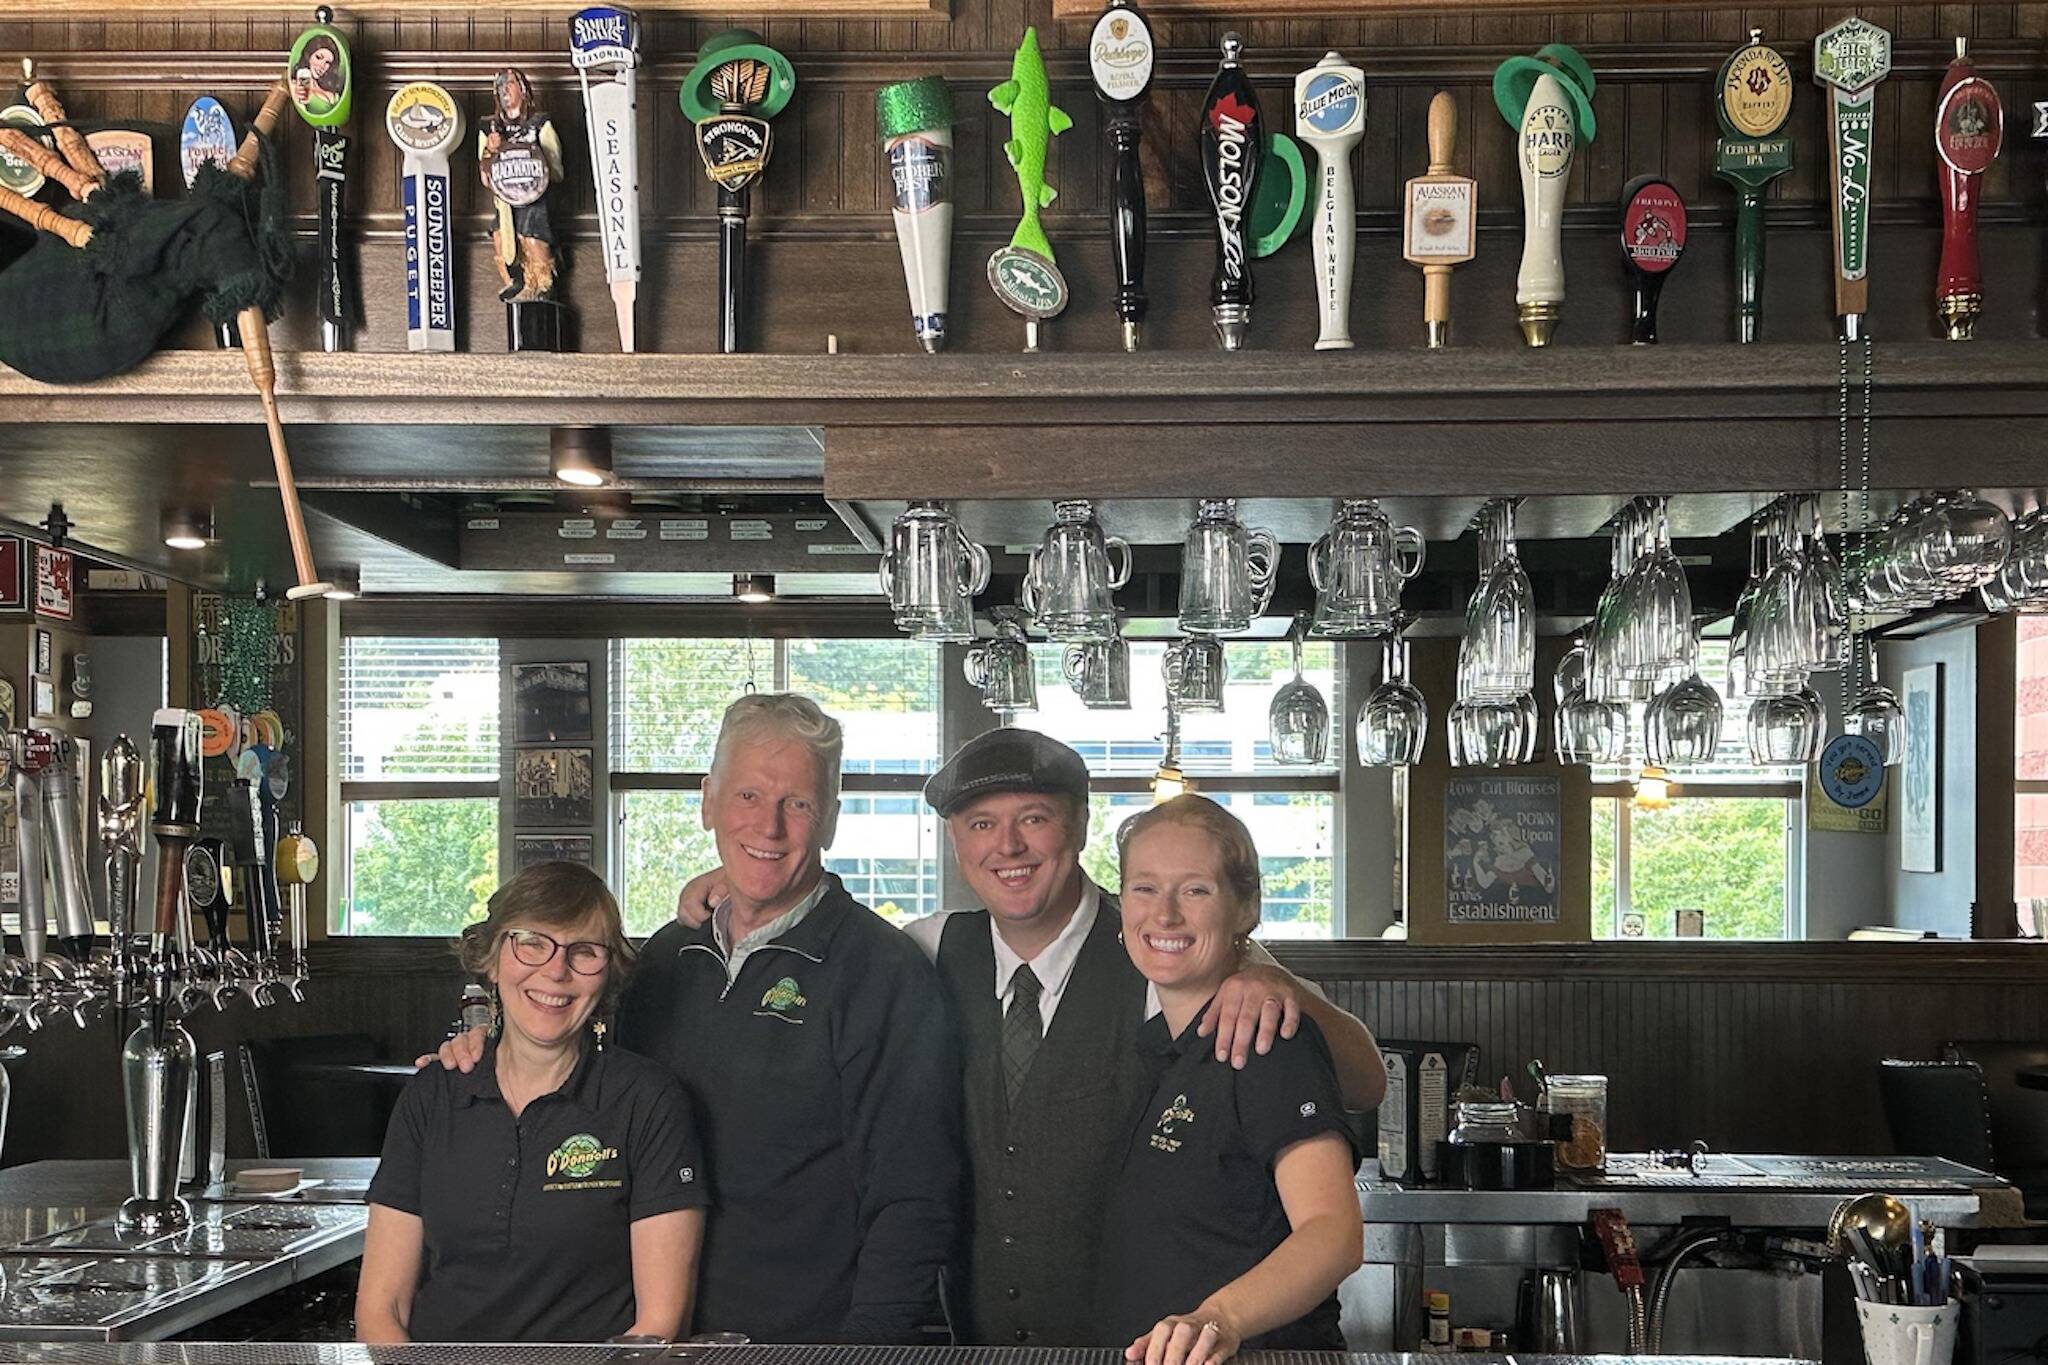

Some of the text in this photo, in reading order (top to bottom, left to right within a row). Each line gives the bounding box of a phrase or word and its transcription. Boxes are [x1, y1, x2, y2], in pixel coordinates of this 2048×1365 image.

[1840, 43, 1867, 57] BIG
[1830, 57, 1877, 72] JUICY
[1299, 83, 1360, 120] BLUE MOON
[703, 121, 763, 146] STRONGBOW
[1527, 131, 1573, 149] HARP
[1219, 113, 1246, 221] MOLSON
[605, 120, 629, 270] SEASONAL
[1416, 186, 1467, 201] ALASKAN
[1326, 167, 1336, 311] BELGIAN WHITE
[405, 178, 447, 326] PUGET SOUNDKEEPER
[1506, 781, 1556, 796] Blouses
[1517, 811, 1556, 826] DOWN
[1521, 828, 1553, 843] Upon
[1449, 902, 1555, 920] Establishment
